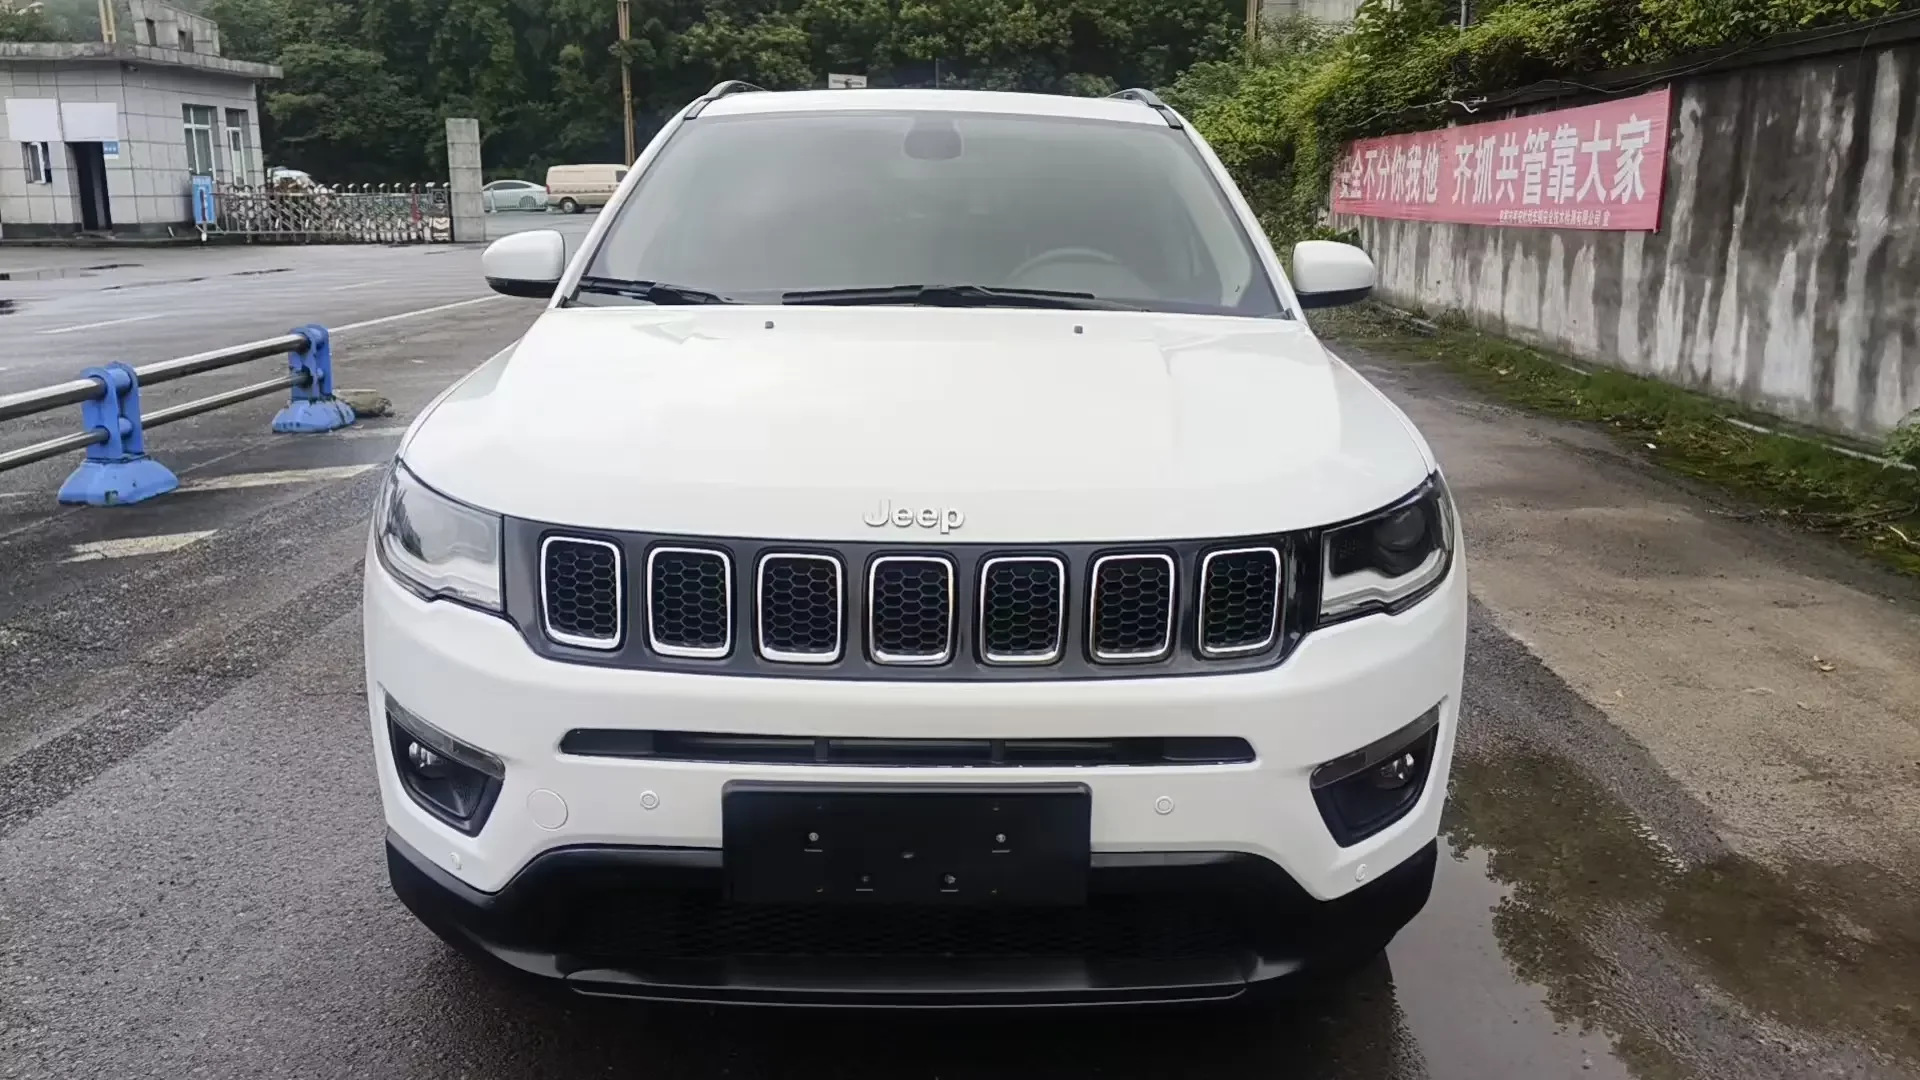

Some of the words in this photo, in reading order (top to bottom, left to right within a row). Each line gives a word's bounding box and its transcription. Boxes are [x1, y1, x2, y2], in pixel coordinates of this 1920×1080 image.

[1452, 113, 1651, 205] 齐抓共管靠大家
[863, 499, 965, 535] Jeep
